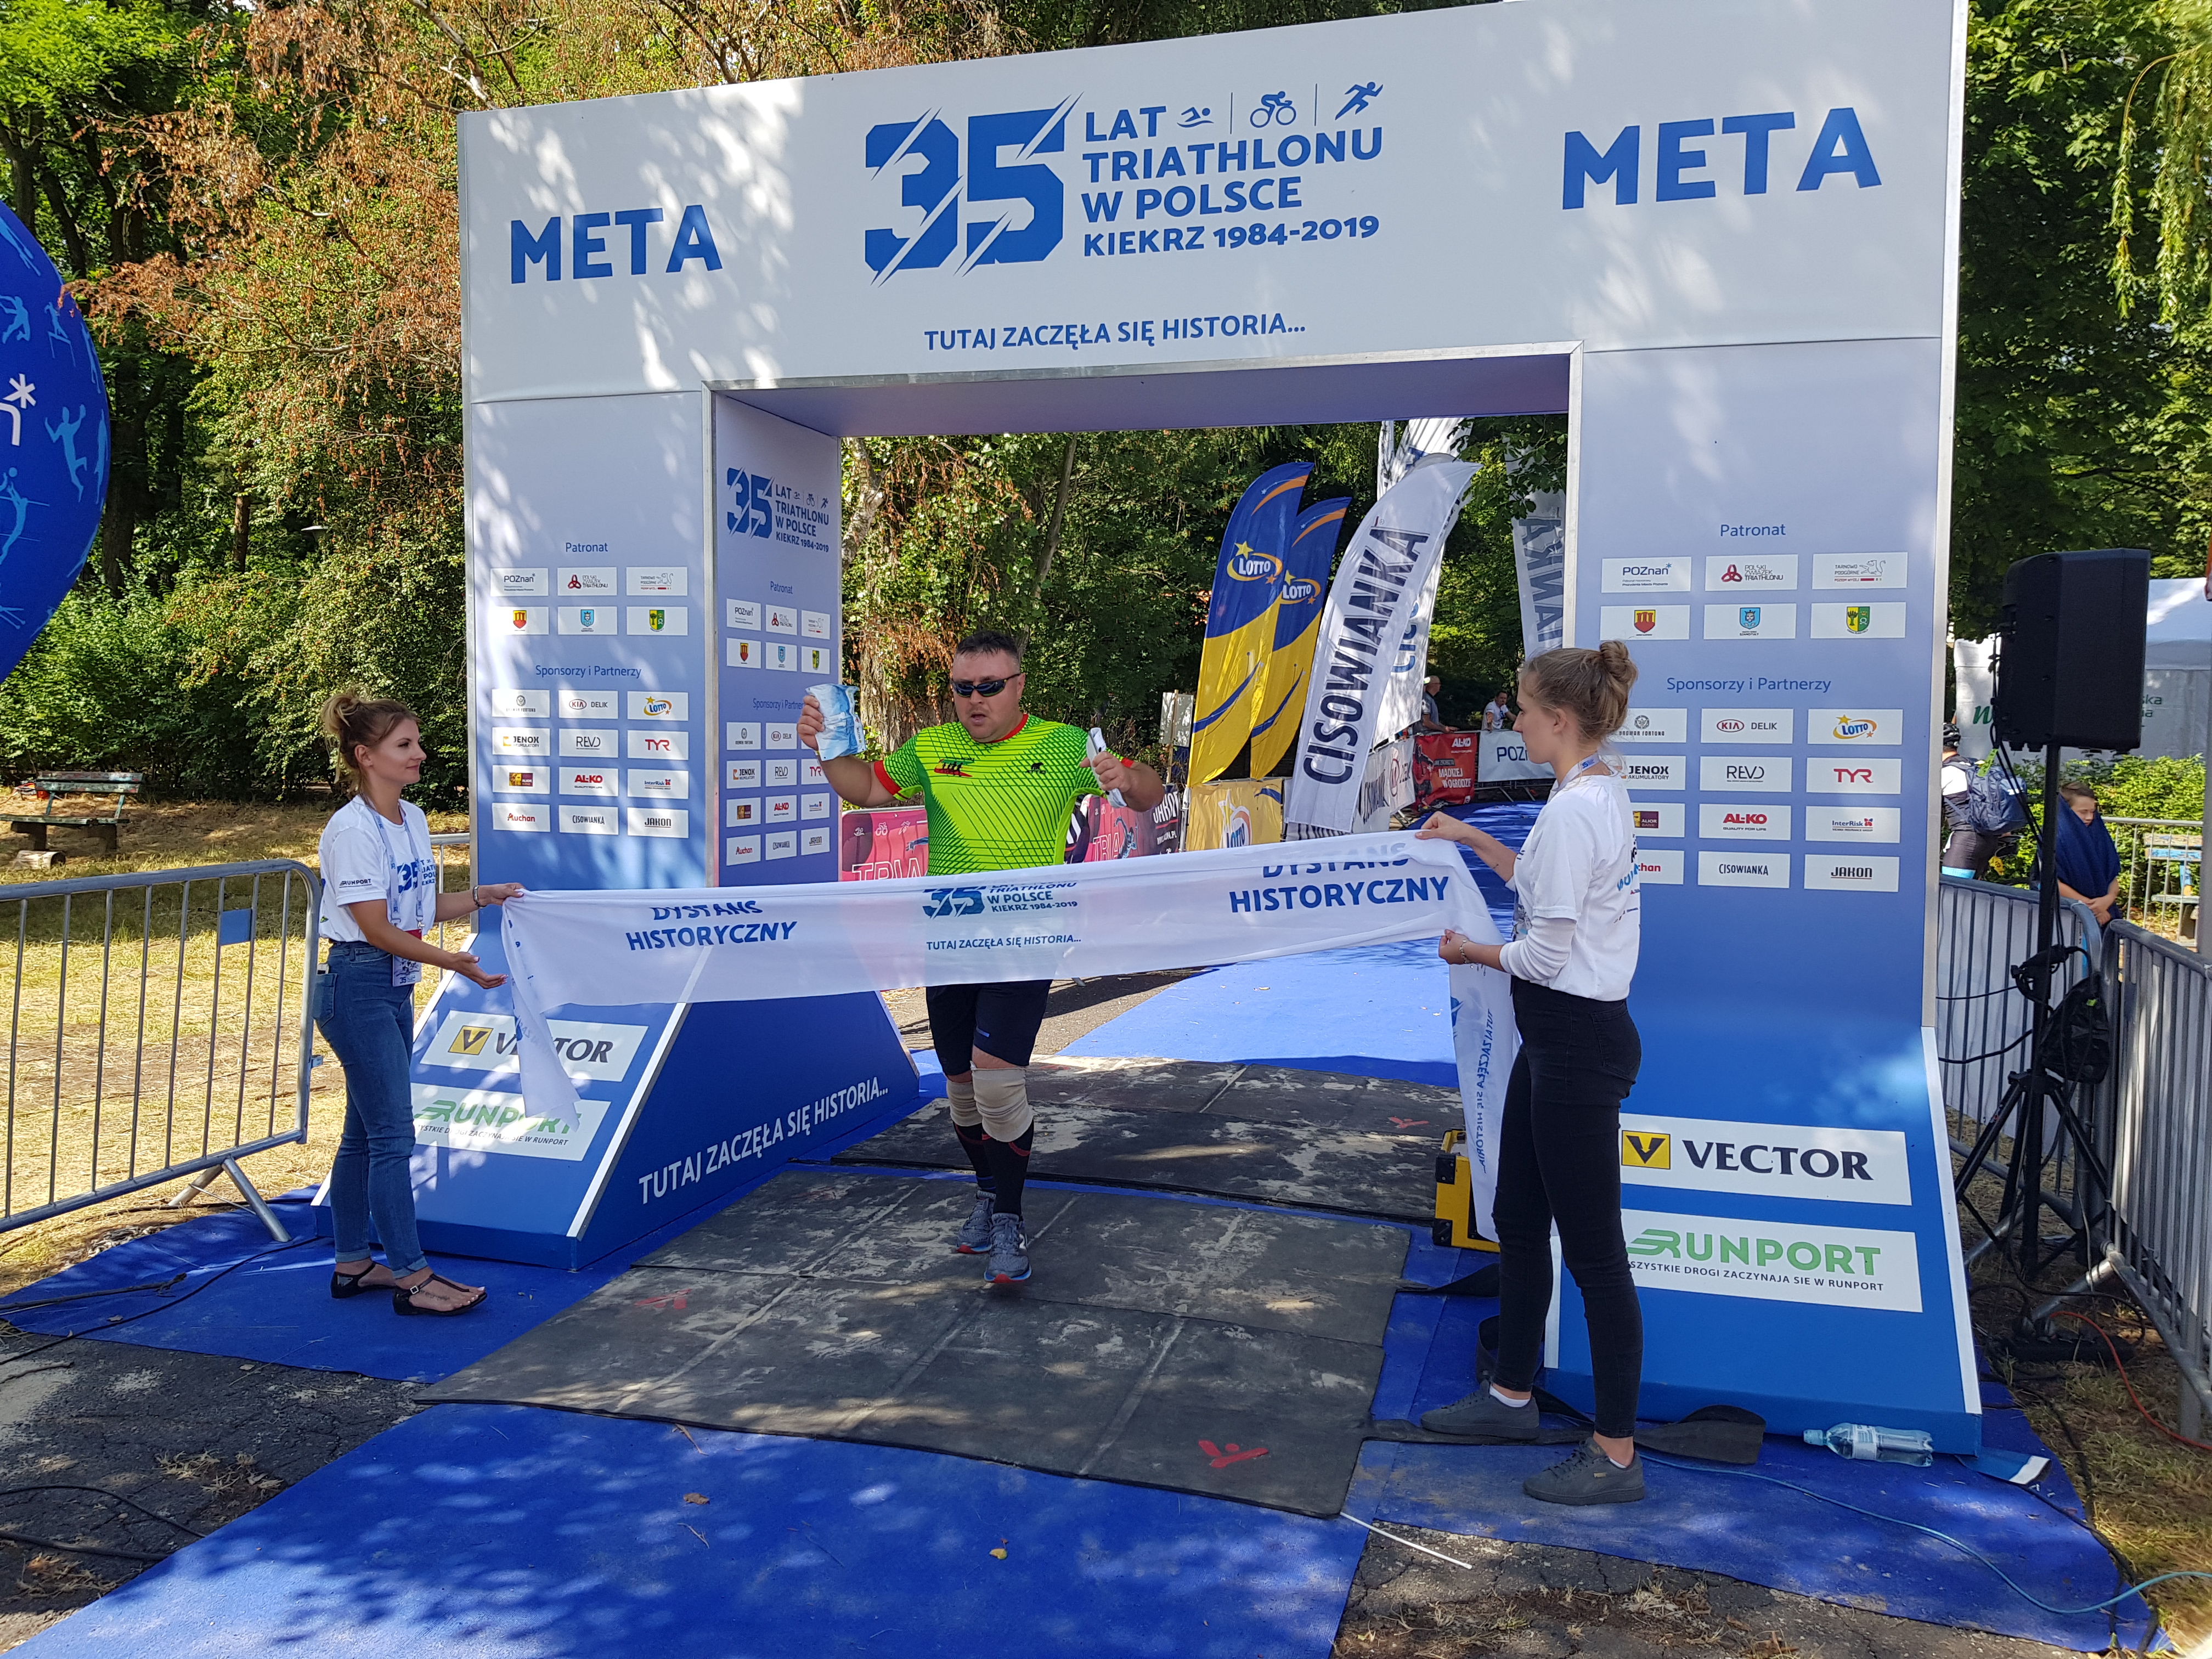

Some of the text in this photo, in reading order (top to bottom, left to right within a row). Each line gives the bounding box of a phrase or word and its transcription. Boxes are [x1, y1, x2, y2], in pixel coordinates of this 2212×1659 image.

[1085, 106, 1167, 143] LAT
[1082, 127, 1383, 183] TRIATHLONU
[1562, 107, 1882, 210] META
[865, 92, 1084, 287] 35
[1081, 176, 1302, 222] W POLSCE
[511, 205, 723, 284] META
[1085, 216, 1379, 257] KIEKRZ 1984-2019
[924, 313, 1305, 351] TUTAJ ZACZĘŁA SIĘ HISTORIA...
[776, 484, 792, 500] LAT
[727, 467, 775, 539] 35
[775, 500, 829, 526] TRIATHLONU
[775, 515, 816, 537] W POLSCE
[1719, 523, 1786, 537] Patronat
[566, 542, 608, 552] Patronat
[776, 531, 830, 553] KIEKRZ 1984-2019
[1239, 558, 1271, 576] LOTTO
[770, 581, 793, 594] Patronat
[1283, 584, 1312, 601] LOTTO
[1303, 524, 1430, 785] CISOWIANKA
[535, 665, 641, 679] Sponsorzy i Partnerzy
[1667, 677, 1831, 693] Sponsorzy i Partnerzy
[649, 703, 667, 713] LOTTO
[753, 698, 803, 710] Sponsorzy i Partner
[1721, 721, 1778, 730] KIA DELIK
[1842, 723, 1869, 736] LOTTO
[645, 739, 672, 751] TYR
[1452, 737, 1471, 748] AL-KO
[1497, 746, 1528, 763] POZ
[739, 768, 755, 776] JENOX
[810, 766, 822, 777] TYR
[1629, 765, 1669, 775] JENOX
[1833, 768, 1873, 783] TYR
[574, 775, 603, 783] AL-KO
[774, 802, 789, 811] AL-KO
[507, 812, 535, 822] Auchan
[572, 815, 605, 825] CISOWIANKA
[645, 817, 672, 827] JAKON
[1723, 813, 1768, 824] AL-KO
[736, 846, 753, 855] Auchan
[1719, 864, 1769, 876] CISOWIANKA
[1831, 867, 1873, 878] JAKON
[339, 878, 371, 887] RUNPORT
[989, 882, 1077, 893] TRIATHLONU
[986, 890, 1053, 905] W POLSCE
[1229, 876, 1449, 913] HISTORYCZNY
[649, 900, 764, 921] DYSTANS
[991, 901, 1078, 912] KIEKRZ 1984-2019
[625, 920, 798, 951] HISTORYCZNY
[926, 934, 1081, 950] TUTAJ ZACZĘŁA SIĘ HISTORIA...
[496, 1032, 615, 1063] VTOR
[444, 1126, 467, 1135] DOGI
[533, 1137, 569, 1146] RUNPORT
[639, 1076, 889, 1205] TUTAJ ZACZĘŁA SIĘ HISTORIA...
[1681, 1139, 1874, 1181] VECTOR
[1627, 1228, 1881, 1276] RUNPORT
[1630, 1261, 1884, 1291] SZYSTKIE DROGI ZACZYNAJA SIE W RUNPORT
